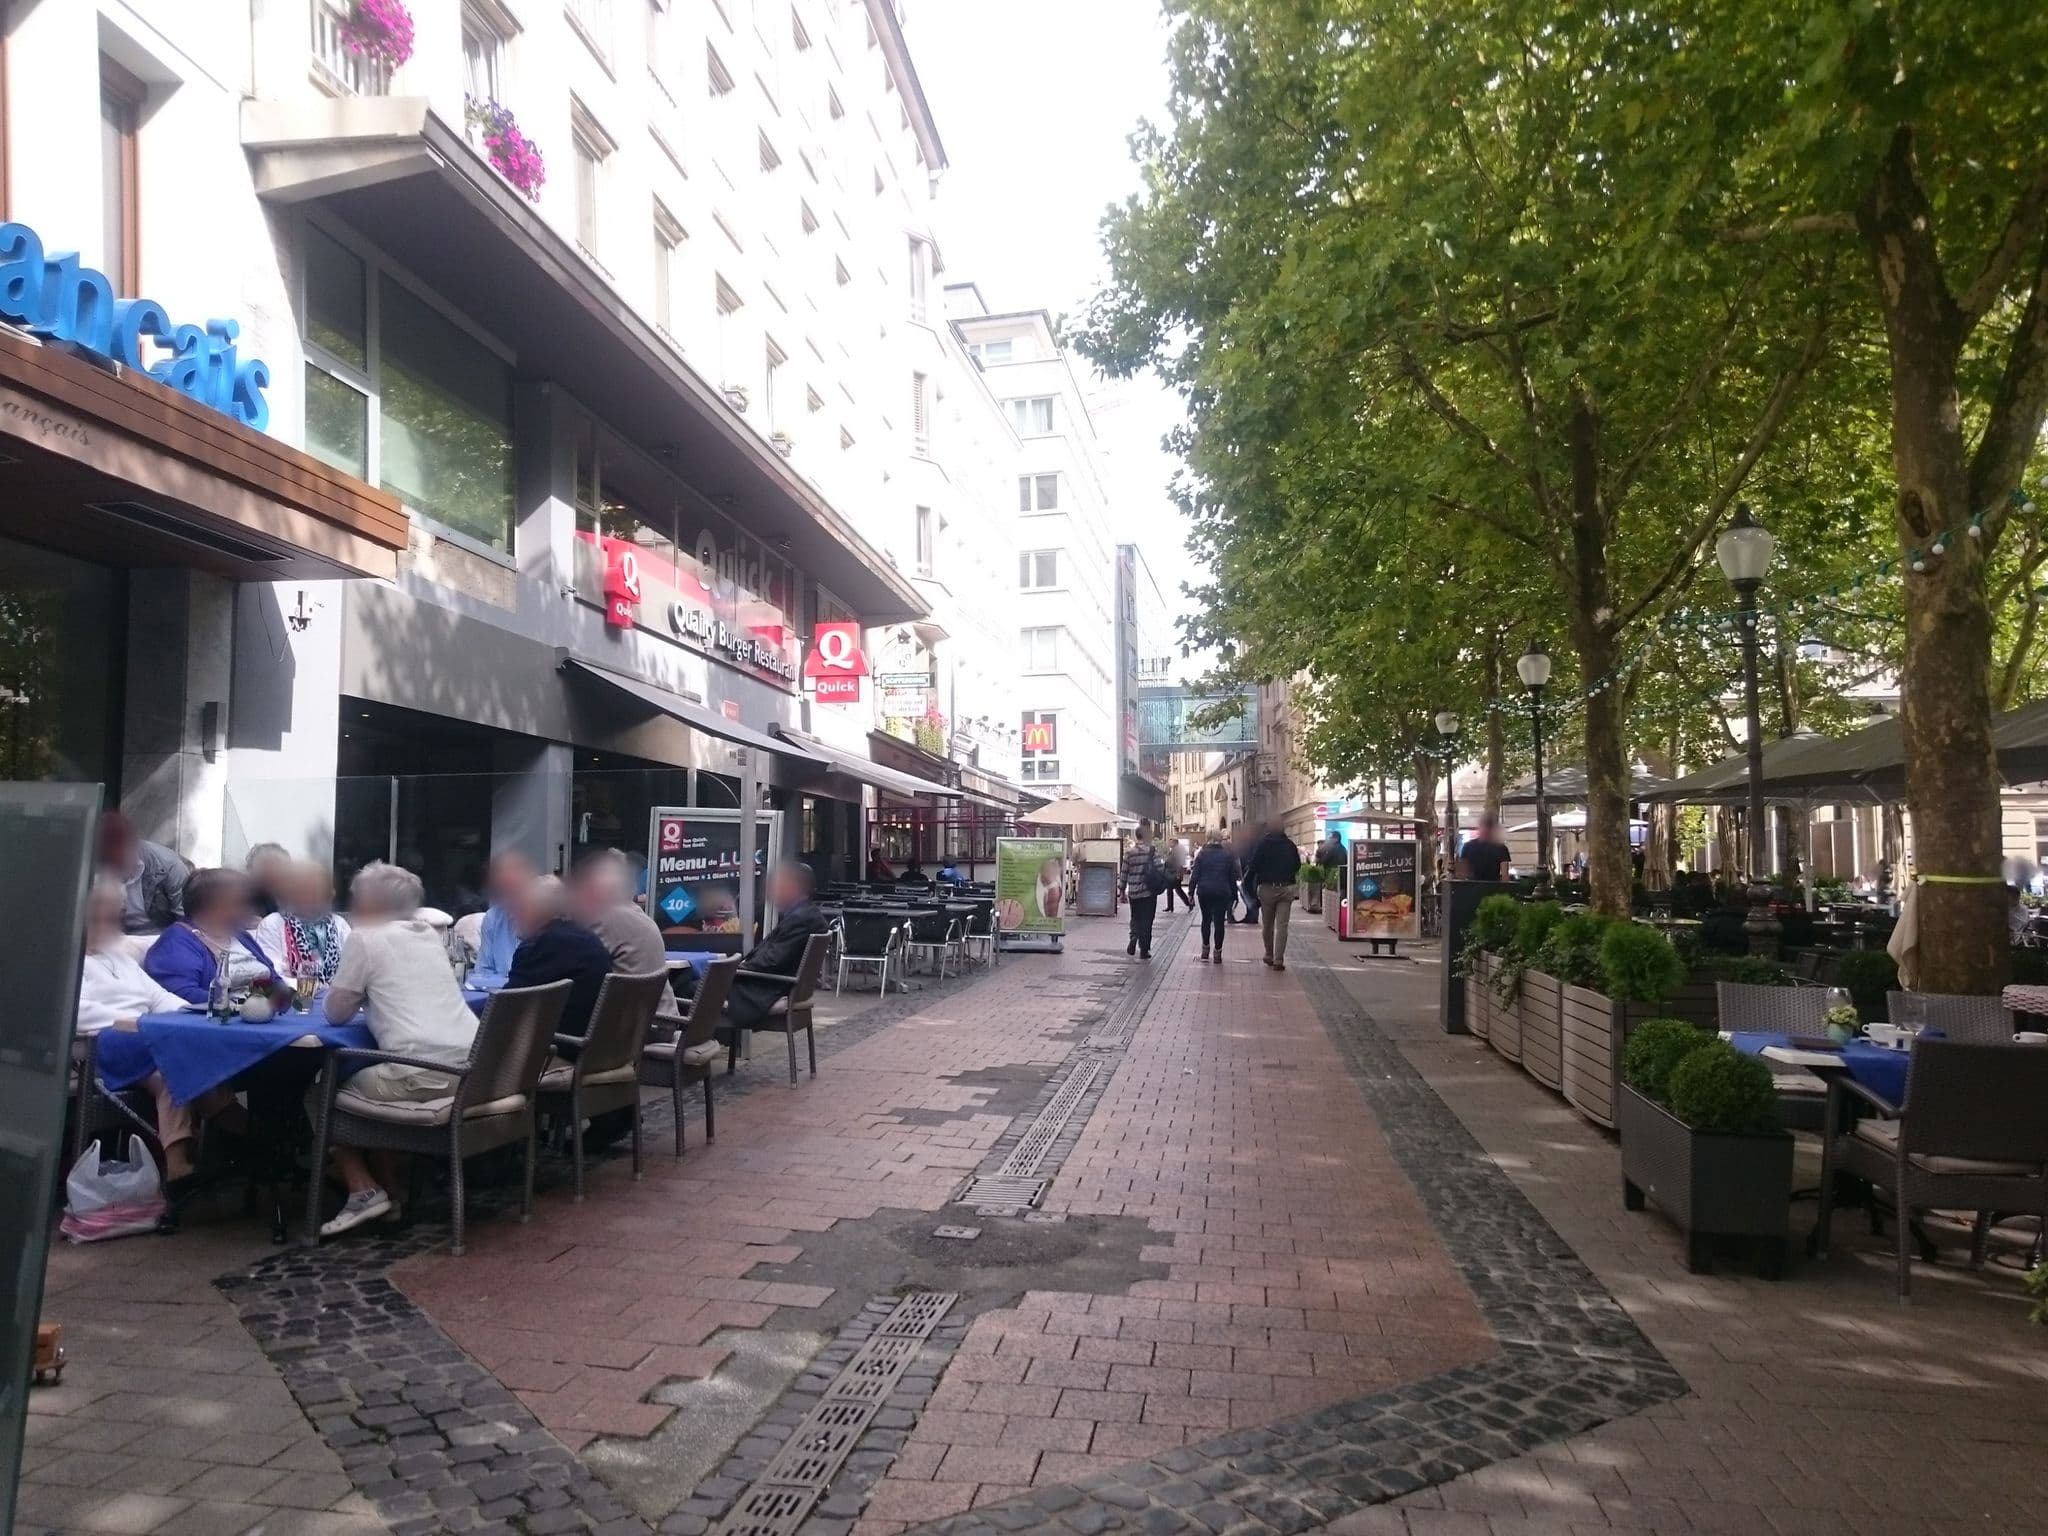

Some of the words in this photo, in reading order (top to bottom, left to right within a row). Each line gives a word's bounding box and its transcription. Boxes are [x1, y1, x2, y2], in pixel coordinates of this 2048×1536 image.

[623, 551, 640, 596] Q
[673, 600, 716, 650] Quality
[719, 621, 752, 661] Burger
[754, 640, 799, 680] Restaurant
[818, 630, 854, 670] Q
[817, 681, 855, 695] Quick
[663, 822, 681, 843] Q
[660, 857, 707, 872] Menu
[1356, 862, 1383, 871] Menu
[1390, 857, 1413, 868] LUX
